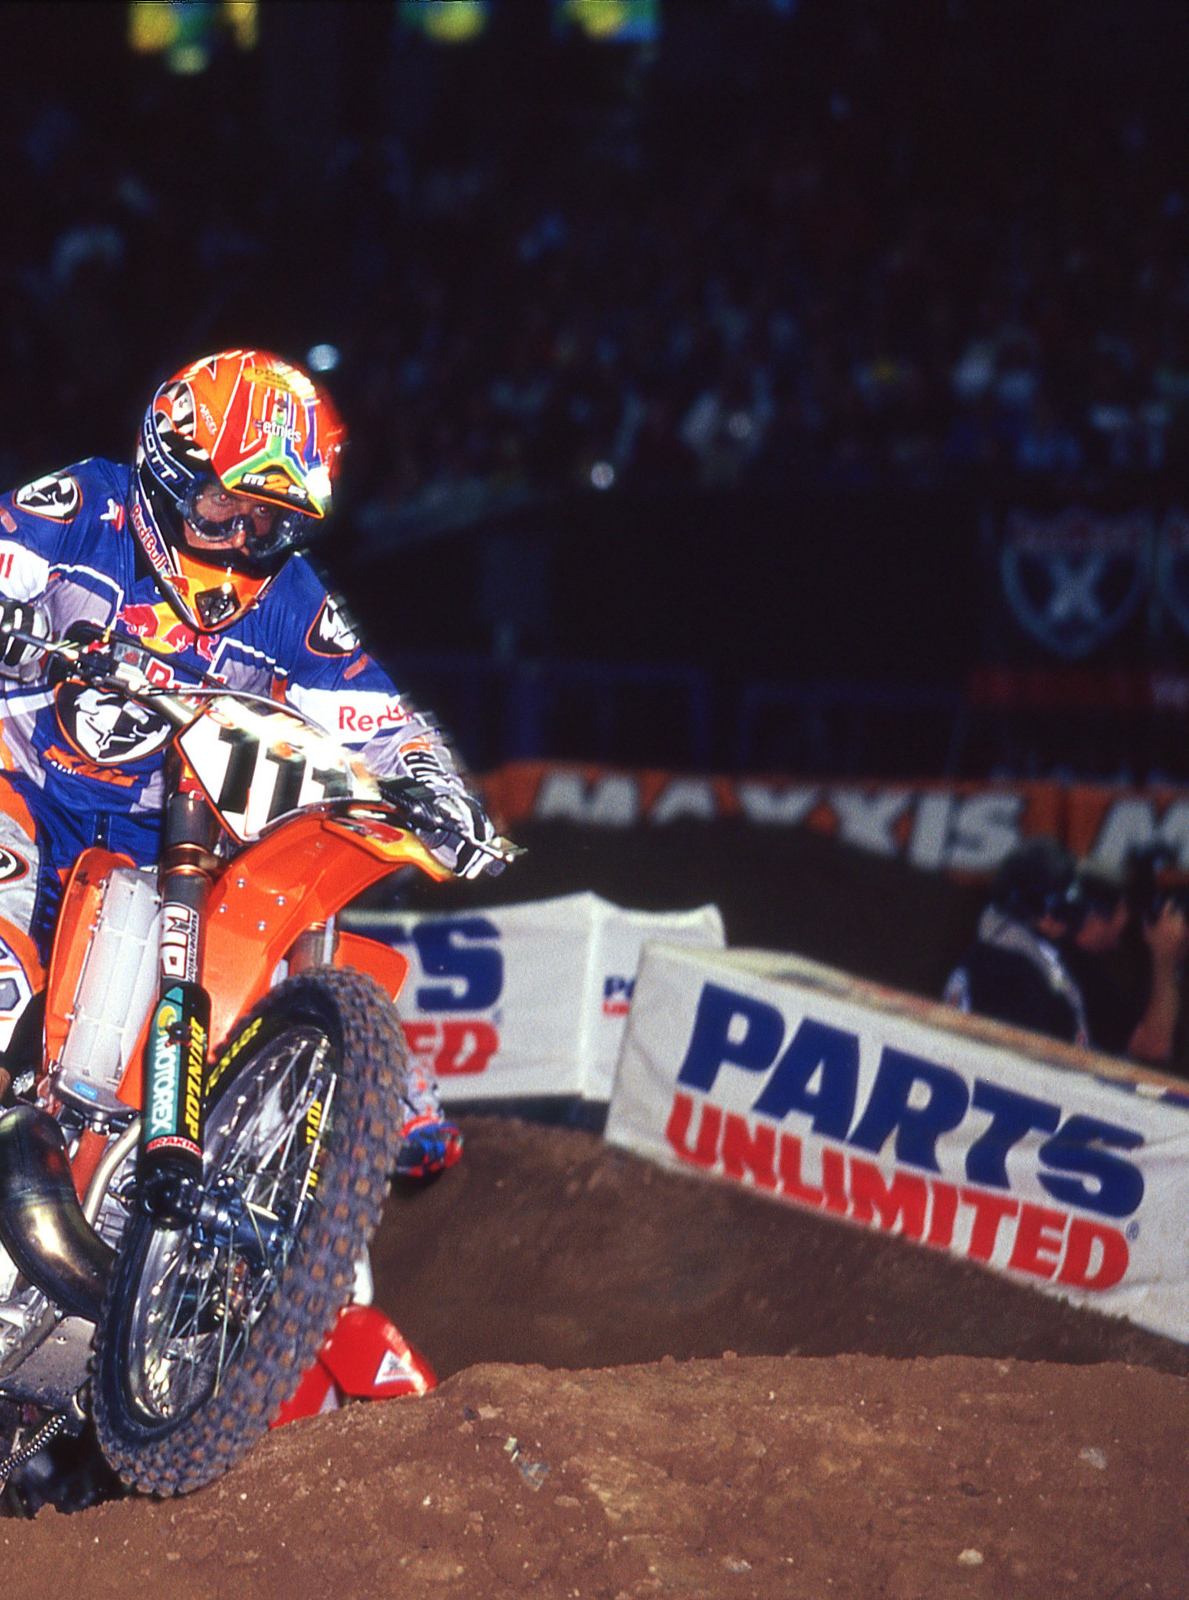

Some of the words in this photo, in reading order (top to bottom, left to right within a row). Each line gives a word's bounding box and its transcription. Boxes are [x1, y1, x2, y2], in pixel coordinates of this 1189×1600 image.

[263, 421, 302, 442] etnies
[151, 1034, 176, 1135] MOTOREX
[185, 1016, 204, 1140] DUNLOP
[677, 981, 1144, 1217] PARTS
[666, 1092, 1129, 1291] UNLIMITED
